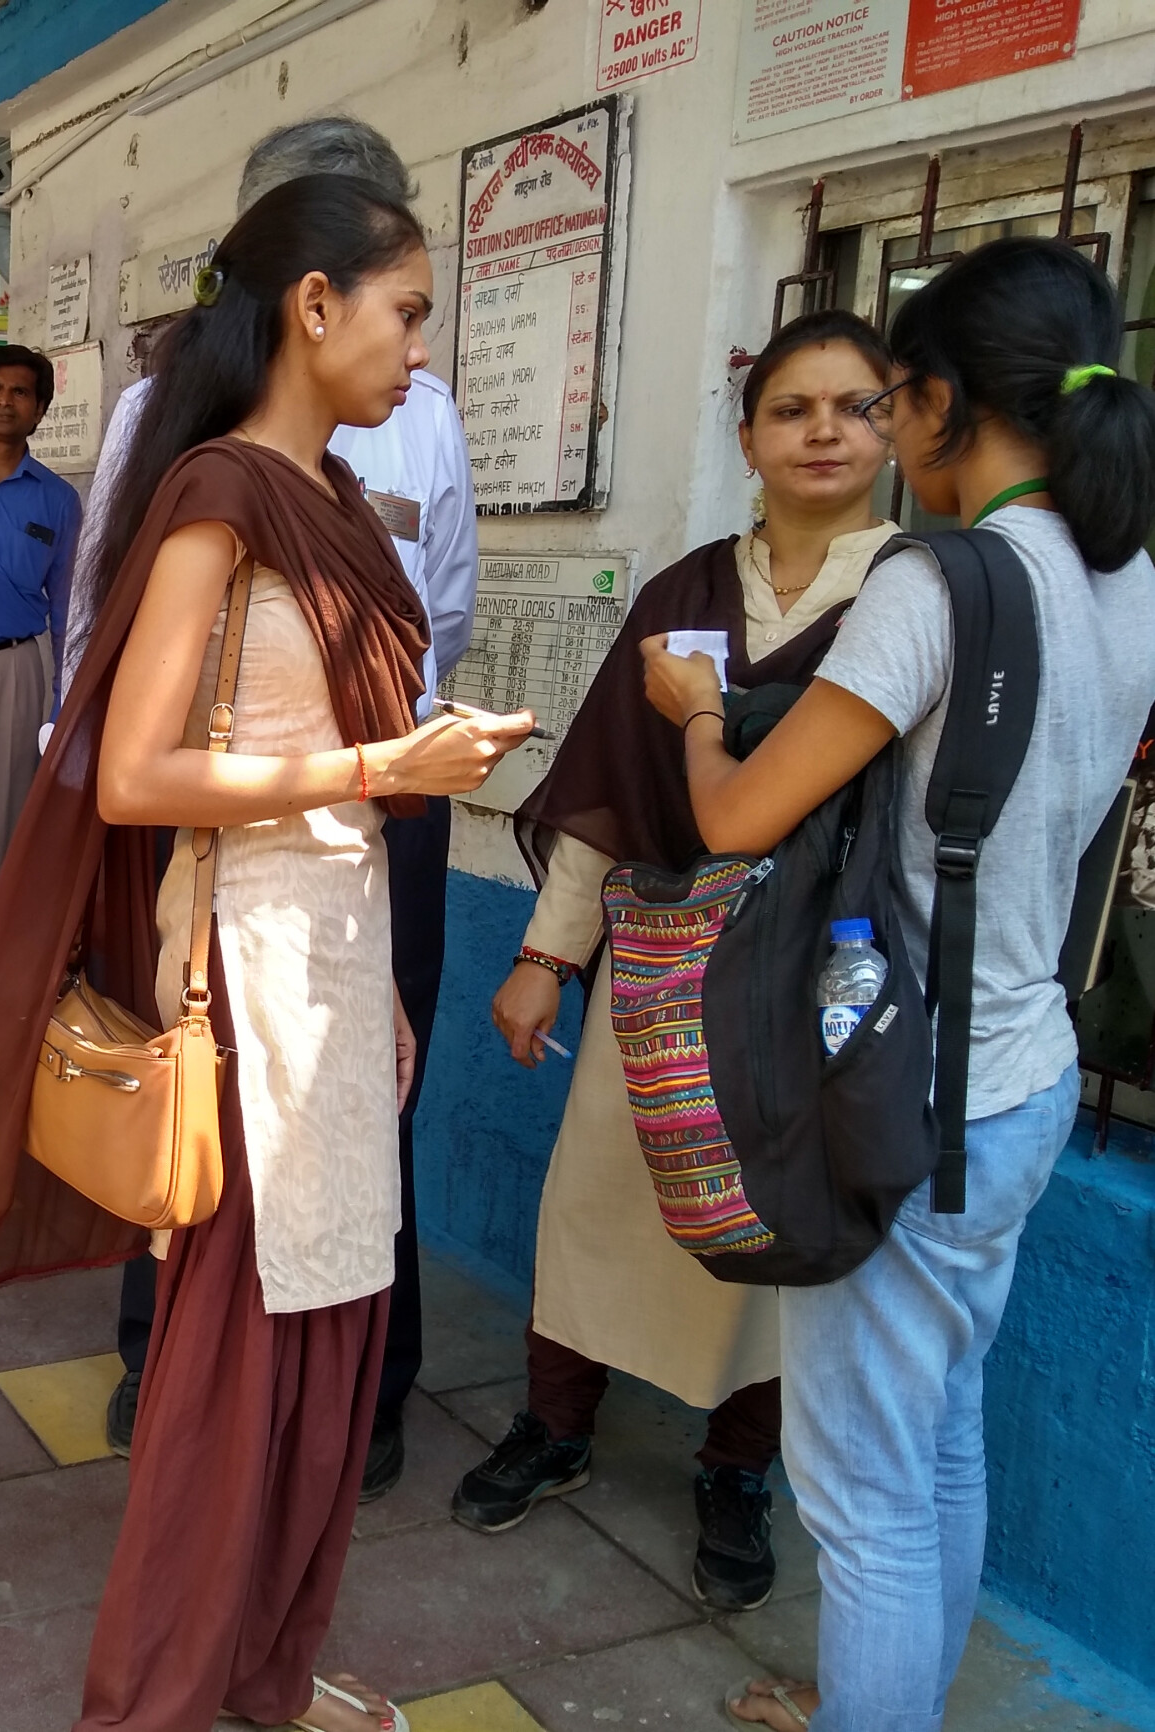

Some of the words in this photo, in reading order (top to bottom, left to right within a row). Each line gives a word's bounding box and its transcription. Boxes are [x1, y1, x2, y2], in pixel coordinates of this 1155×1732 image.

[935, 9, 957, 23] HIGH
[960, 0, 998, 15] VOLTAGE
[1005, 6, 1018, 15] NOT
[1046, 3, 1064, 12] NEAR
[772, 22, 823, 47] CAUTION
[826, 6, 869, 30] NOTICE
[1032, 12, 1063, 25] TRACTION
[614, 10, 682, 52] DANGER
[859, 34, 878, 44] PUBLIC
[879, 30, 890, 38] ARE
[775, 46, 792, 58] HIGH
[793, 36, 826, 52] VOLTAGE
[828, 24, 864, 41] TRACTION
[861, 40, 889, 51] TRACTION
[1014, 49, 1026, 60] BY
[1028, 41, 1059, 56] ORDER
[641, 48, 667, 68] Volts
[849, 95, 859, 104] BY
[860, 88, 883, 101] ORDER
[466, 232, 502, 259] STATION
[534, 214, 564, 240] OFFICE
[565, 209, 597, 233] MATUNGA
[158, 254, 192, 294] स्टेशन
[498, 257, 520, 273] NAME
[50, 272, 67, 285] Complaint
[68, 269, 77, 279] Book
[470, 318, 506, 339] SANDHYA
[511, 312, 537, 331] VARMA
[467, 372, 505, 394] ARCHANA
[511, 366, 537, 386] YADAV
[465, 429, 496, 447] SHWETA
[502, 424, 544, 443] KANHORE
[518, 481, 545, 497] HAKIM
[560, 479, 576, 492] SM
[484, 562, 525, 580] MATUNGA
[526, 563, 551, 580] ROAD
[521, 600, 556, 619] LOCALS
[568, 602, 601, 622] BANDRA
